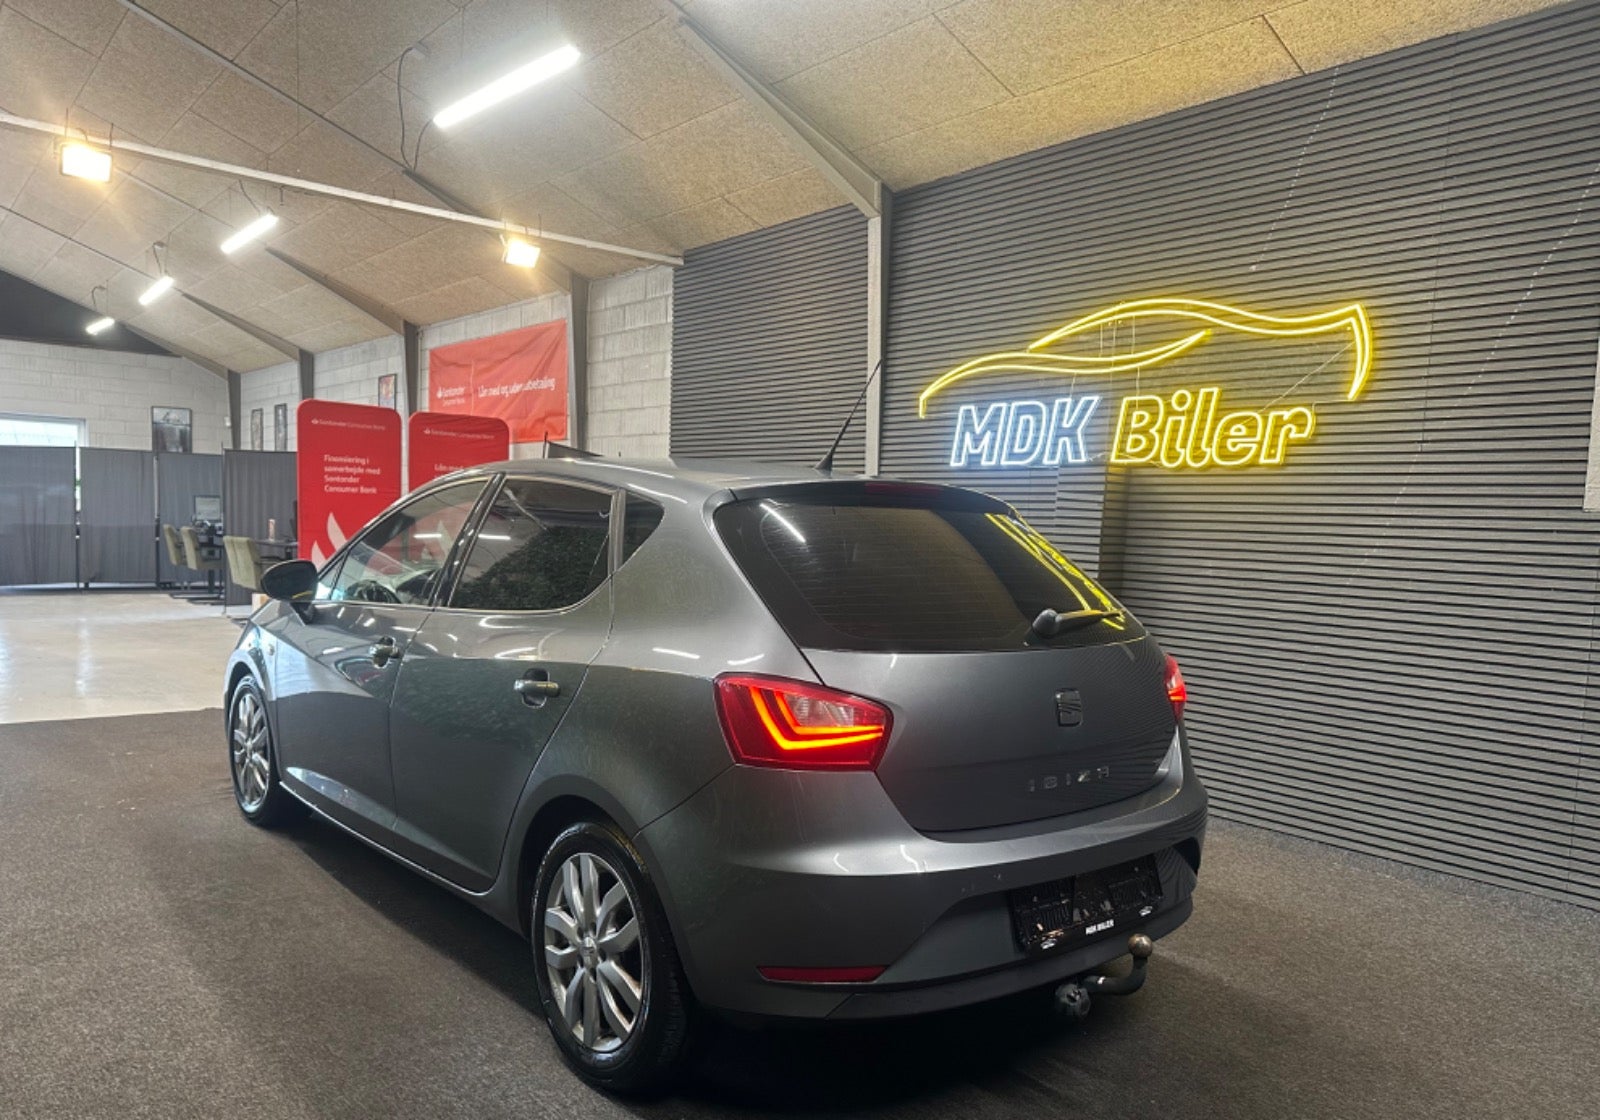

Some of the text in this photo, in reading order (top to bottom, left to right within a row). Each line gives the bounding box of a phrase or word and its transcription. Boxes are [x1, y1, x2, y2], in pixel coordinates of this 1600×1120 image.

[949, 387, 1316, 469] MDK Biler
[324, 454, 366, 465] Finansiering
[324, 465, 381, 475] samarbejde med
[324, 474, 360, 483] Santander
[324, 484, 378, 494] Consumer Bank
[1028, 765, 1110, 793] IBIZA
